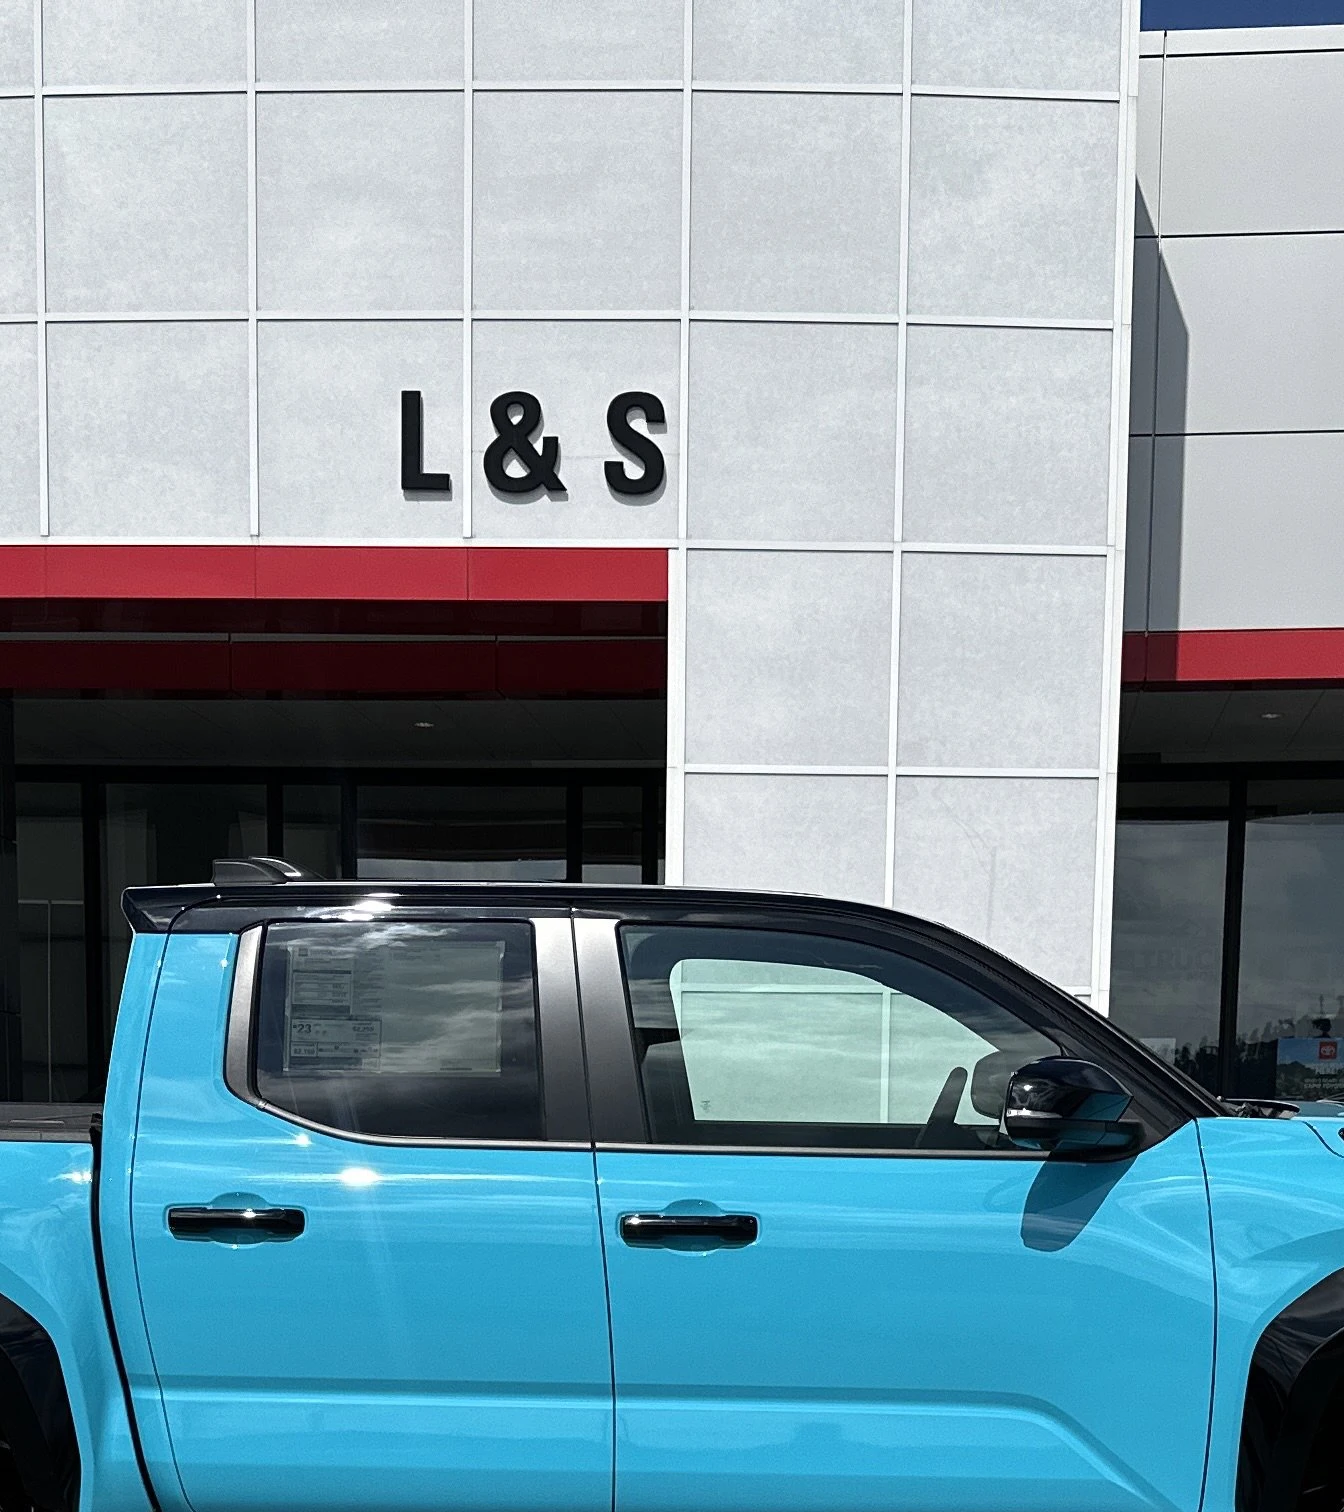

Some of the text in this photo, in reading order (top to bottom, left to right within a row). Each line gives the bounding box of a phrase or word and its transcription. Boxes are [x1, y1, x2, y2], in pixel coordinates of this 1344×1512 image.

[401, 390, 665, 494] L & S
